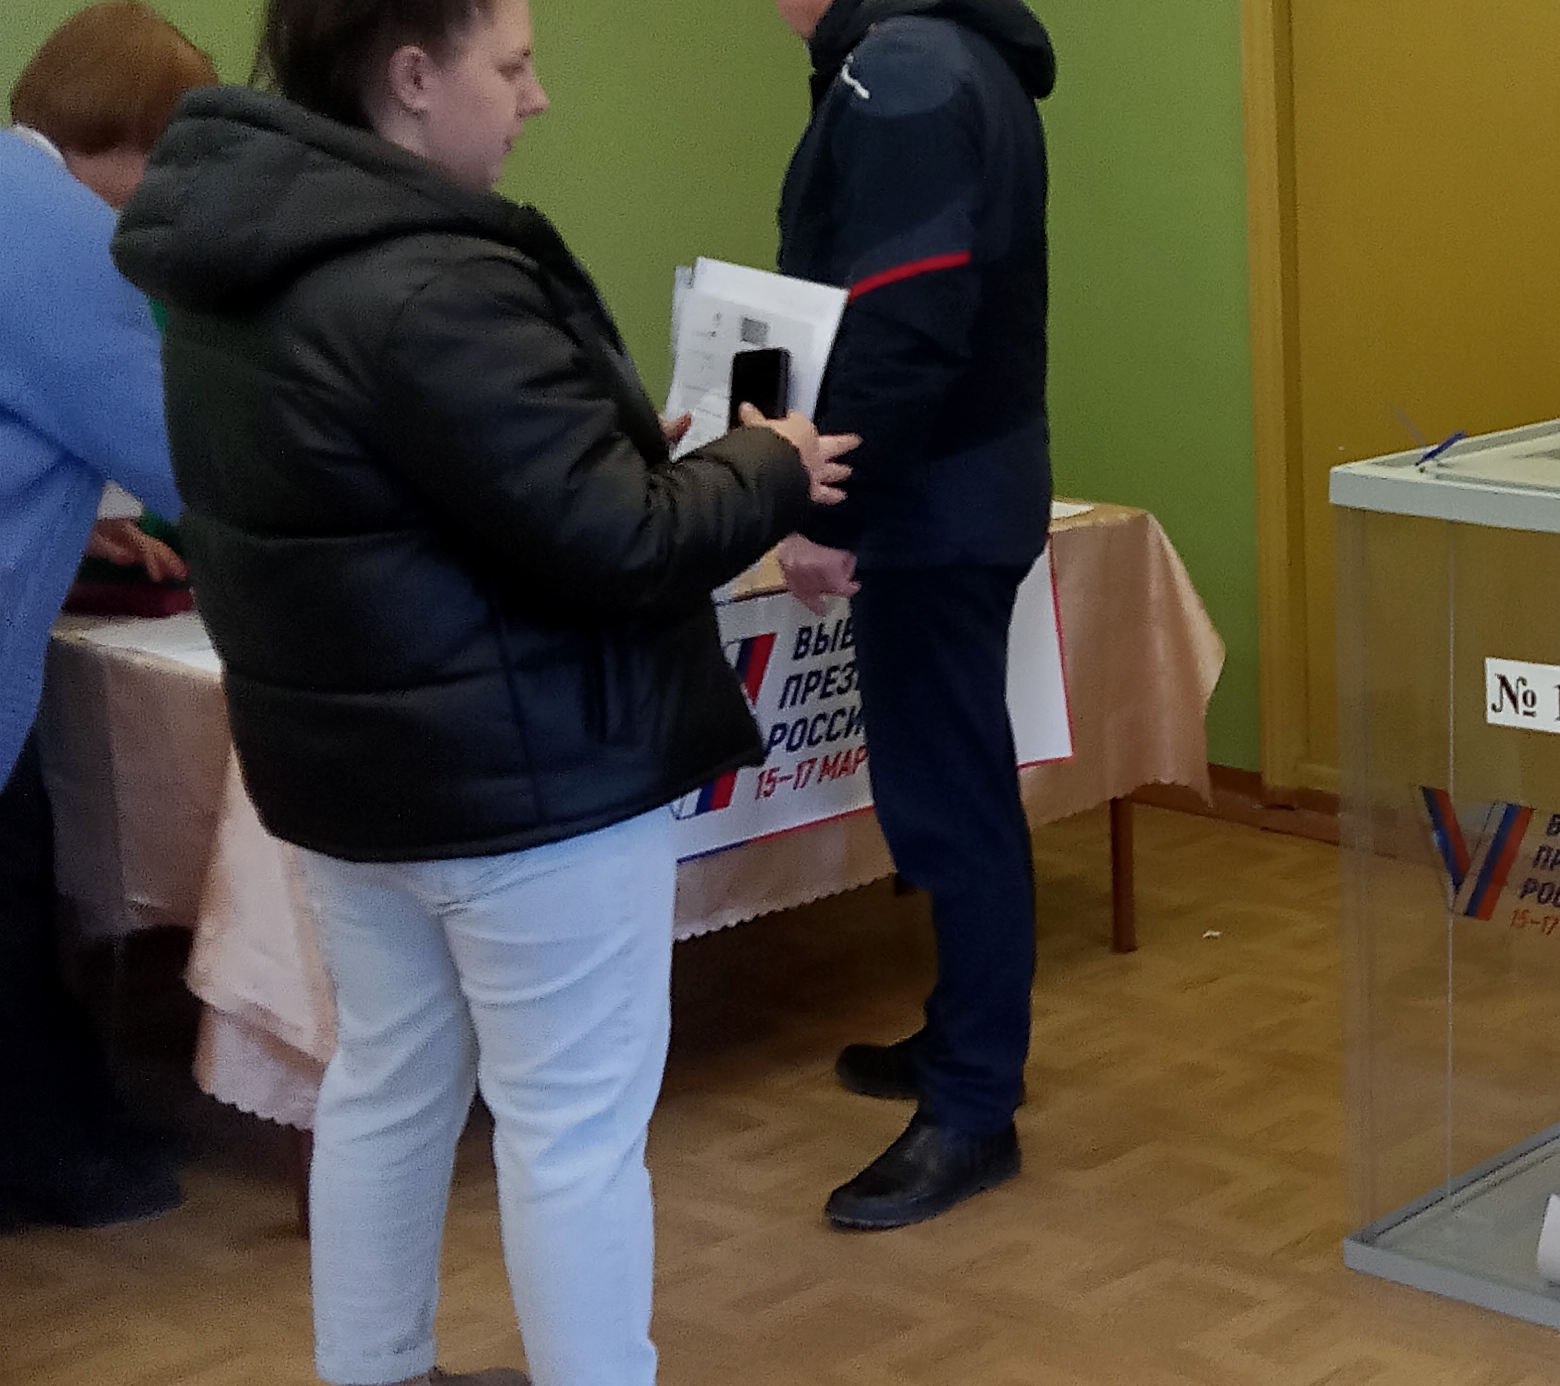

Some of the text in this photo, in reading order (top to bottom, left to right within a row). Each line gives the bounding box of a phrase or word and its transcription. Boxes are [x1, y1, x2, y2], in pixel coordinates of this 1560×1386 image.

[792, 616, 855, 661] ВЫБ
[778, 663, 859, 710] ПРЕЗ
[1490, 673, 1537, 718] №
[764, 706, 862, 760] РОССИ
[818, 745, 869, 784] МАР
